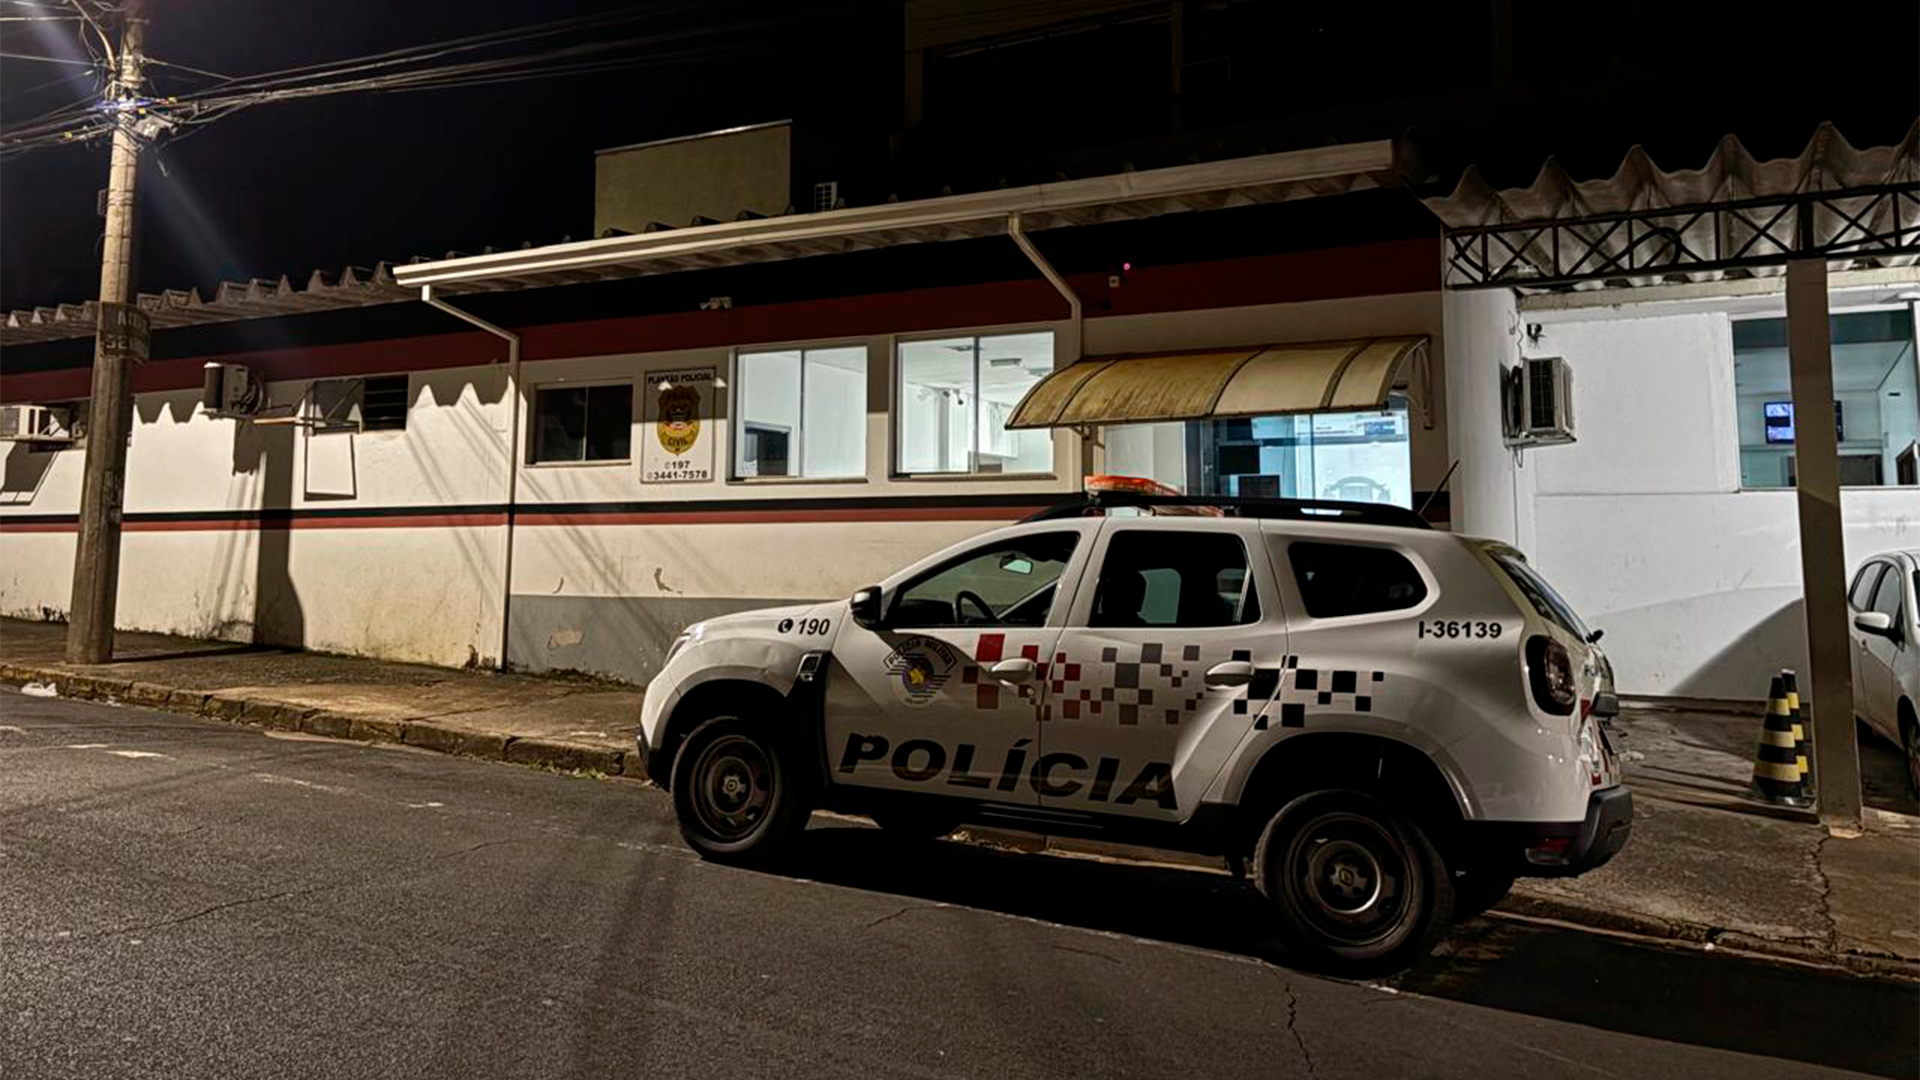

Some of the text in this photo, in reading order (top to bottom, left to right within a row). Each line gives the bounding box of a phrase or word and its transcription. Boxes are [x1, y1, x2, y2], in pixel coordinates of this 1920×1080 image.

[681, 372, 711, 382] POLICIAL
[672, 460, 690, 469] 197
[653, 470, 708, 480] 3441-7578
[798, 618, 830, 636] 190
[1418, 621, 1502, 639] I-36139
[839, 732, 1179, 811] POLÍCIA
